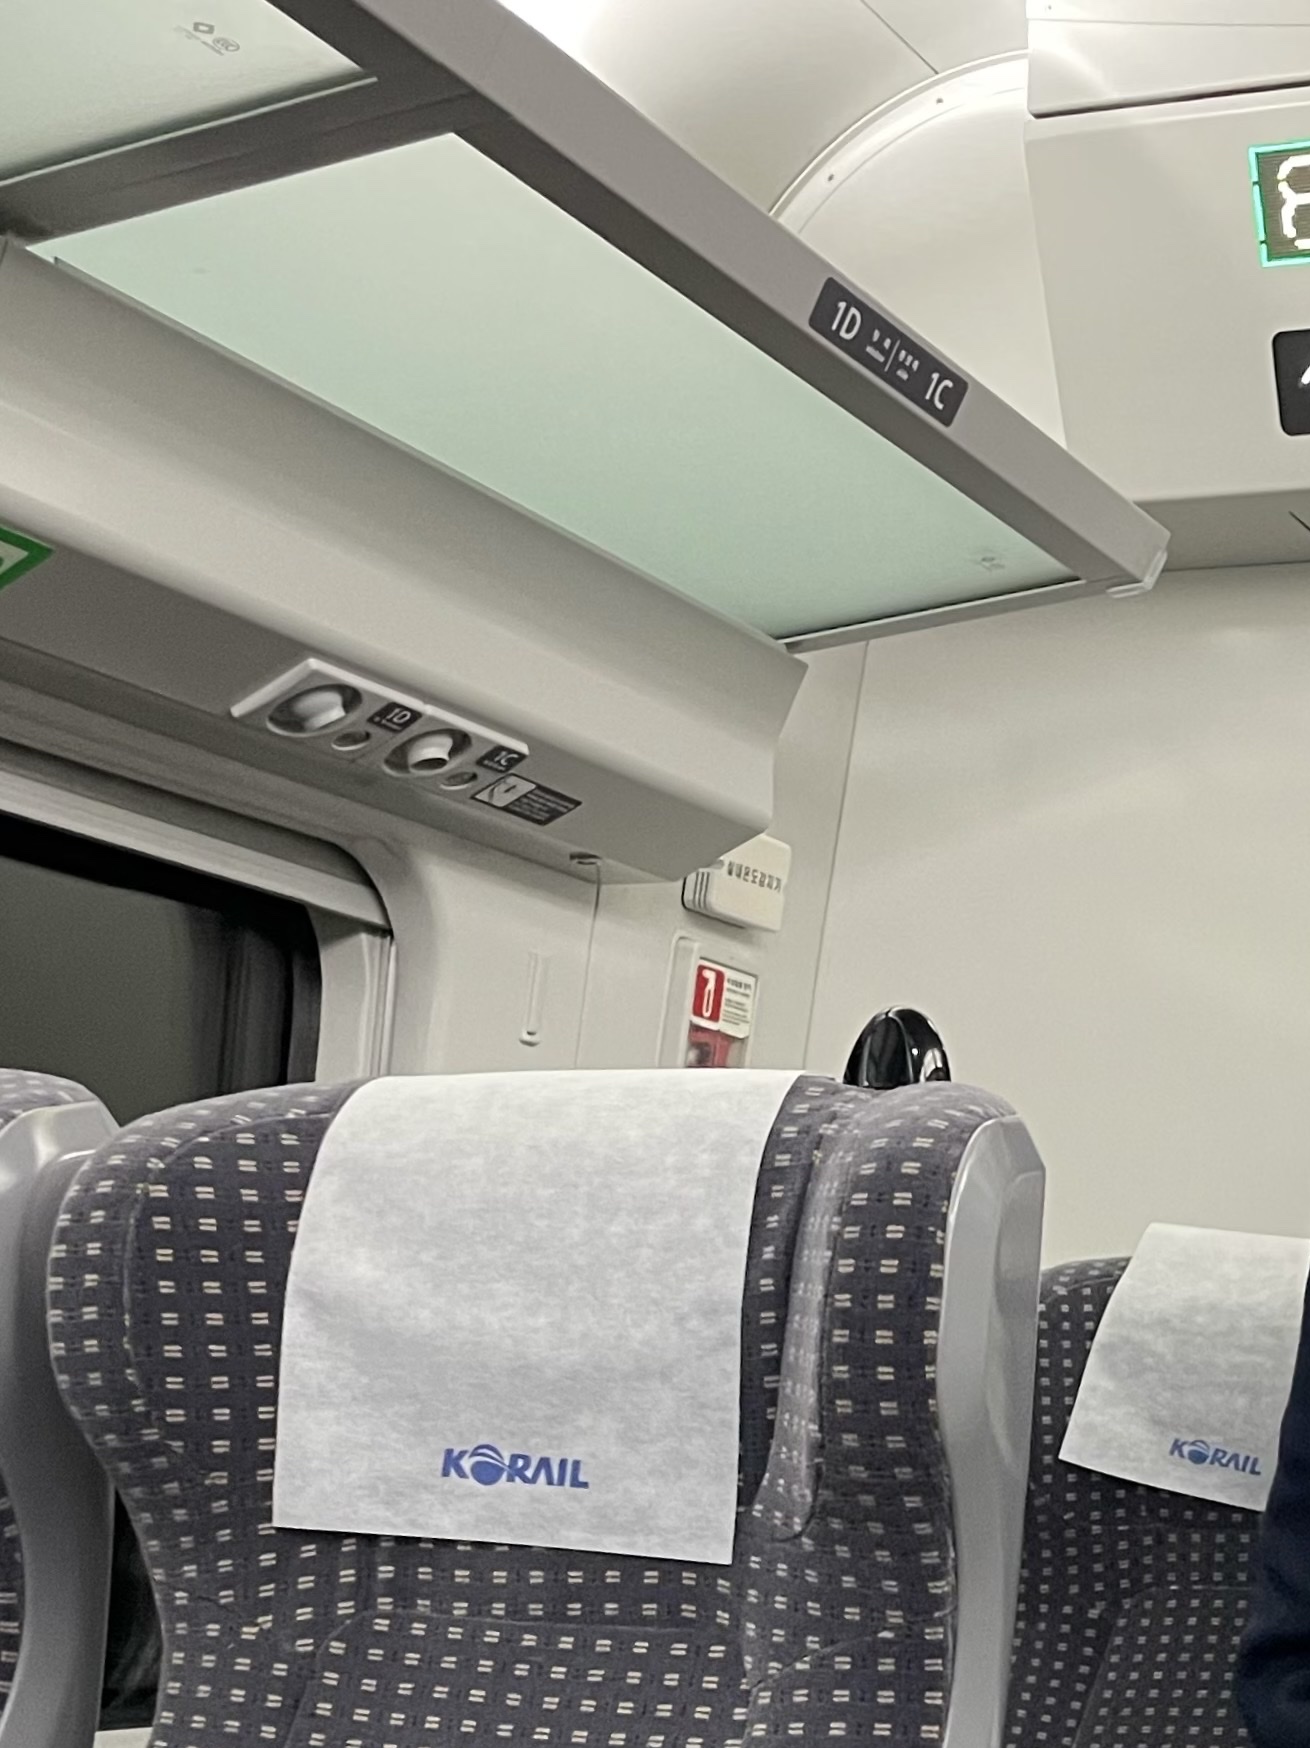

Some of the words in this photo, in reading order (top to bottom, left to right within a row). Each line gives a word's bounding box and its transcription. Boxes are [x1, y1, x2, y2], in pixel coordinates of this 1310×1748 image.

[831, 301, 862, 340] 1D
[925, 372, 954, 410] 1C
[441, 1443, 590, 1489] KORAIL
[1169, 1438, 1262, 1476] KORAIL
